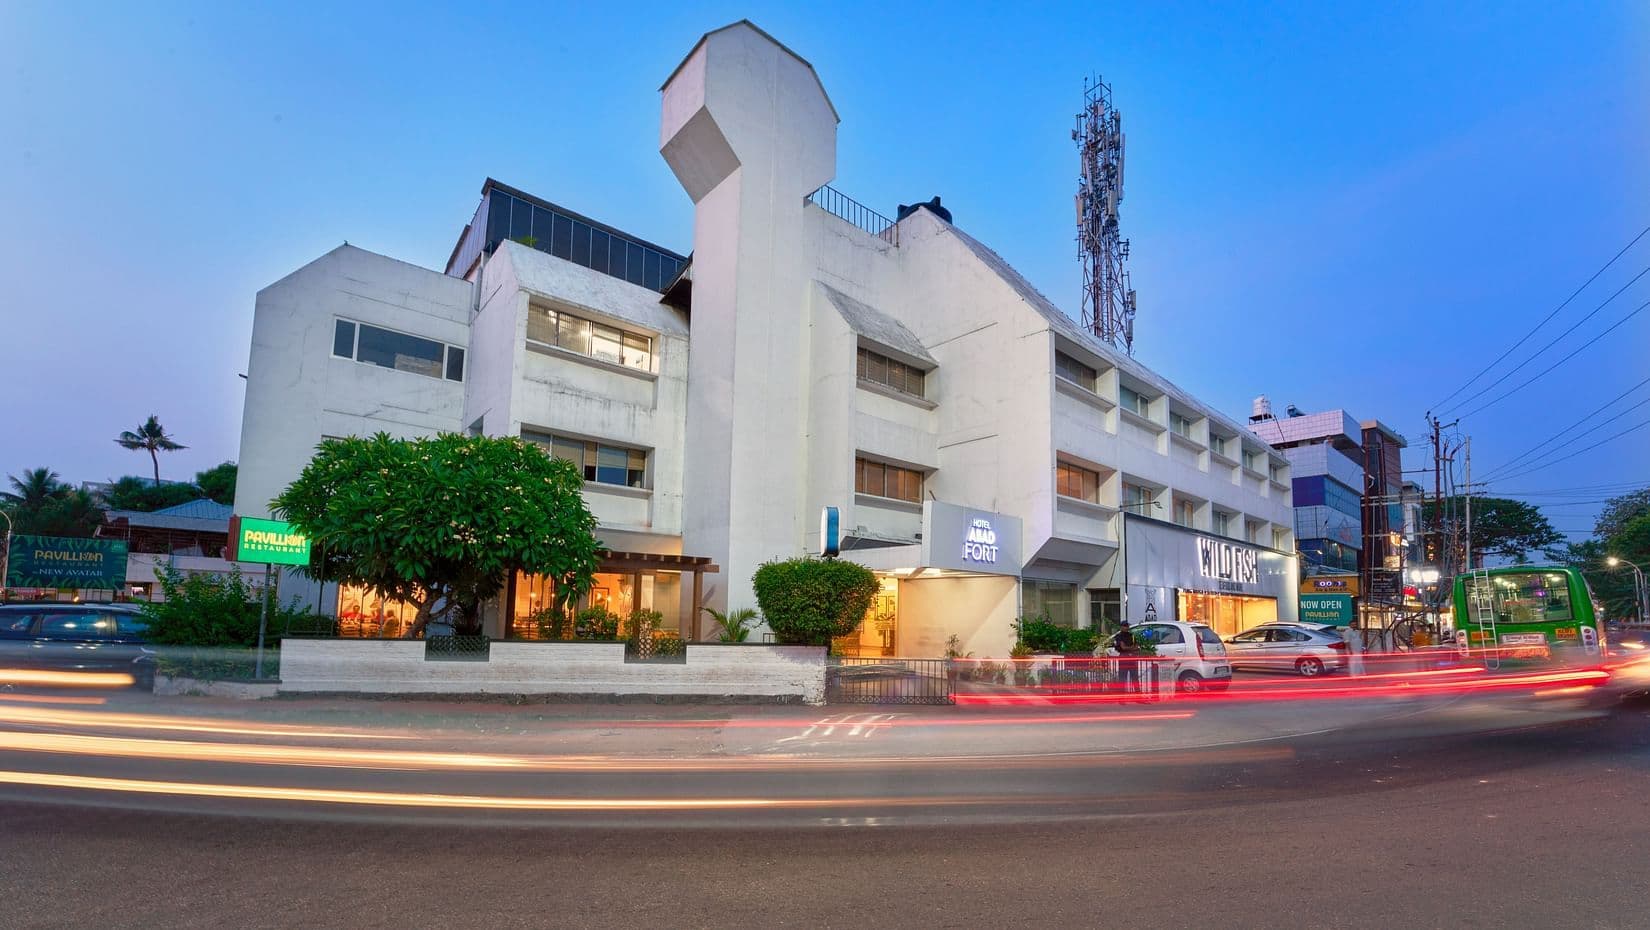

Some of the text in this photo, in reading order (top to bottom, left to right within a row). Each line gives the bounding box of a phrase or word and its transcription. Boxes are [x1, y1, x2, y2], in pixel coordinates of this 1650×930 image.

[973, 518, 991, 529] HOTEL
[244, 530, 306, 547] PAVILLION
[244, 544, 306, 553] RESTAURANT
[964, 542, 998, 562] FORT
[34, 550, 103, 562] PAVILLION
[39, 568, 103, 577] NEW AVATAR
[1300, 600, 1342, 609] NOW OPEN
